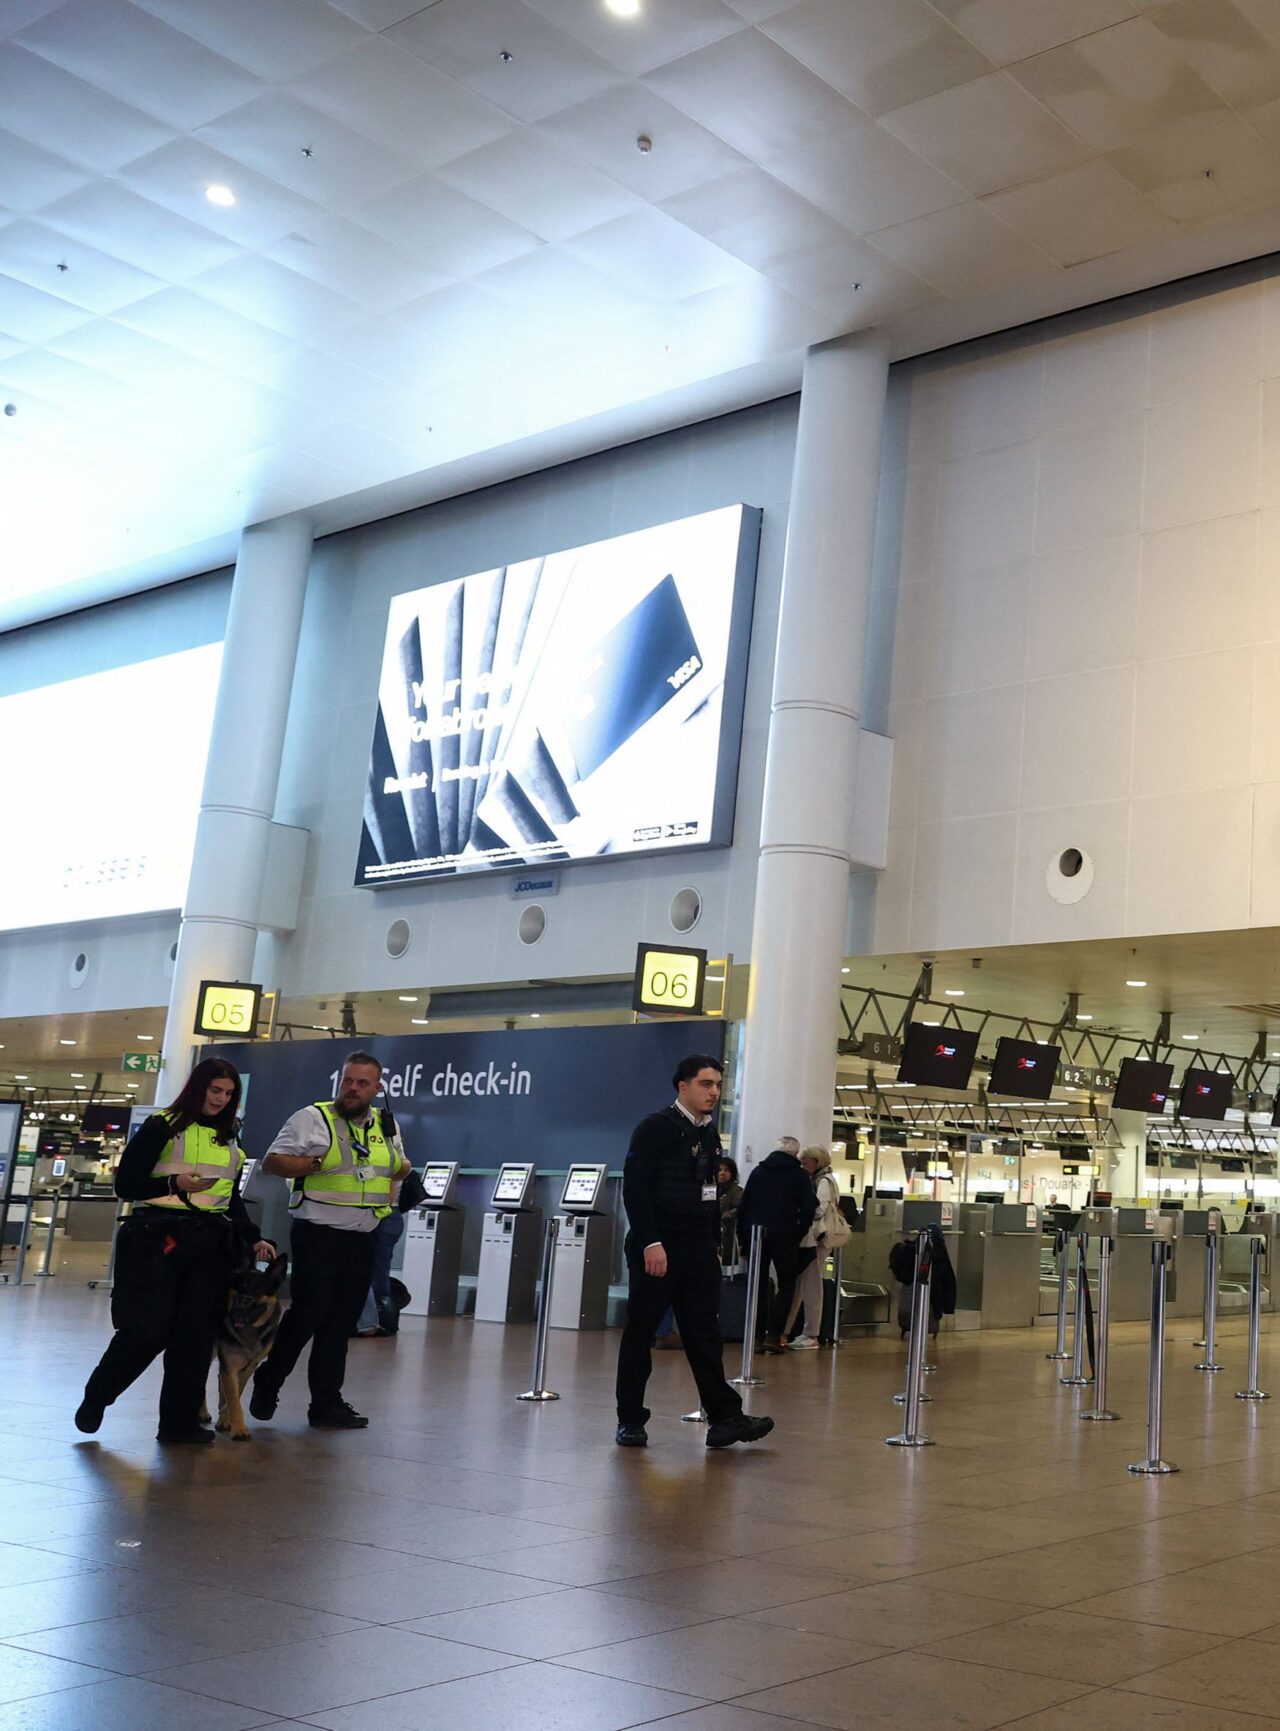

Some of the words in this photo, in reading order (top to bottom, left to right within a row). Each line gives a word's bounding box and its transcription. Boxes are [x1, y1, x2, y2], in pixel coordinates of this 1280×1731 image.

[651, 972, 687, 998] 06
[211, 1003, 244, 1025] 05
[376, 1064, 423, 1098] Self
[432, 1062, 531, 1096] check-in
